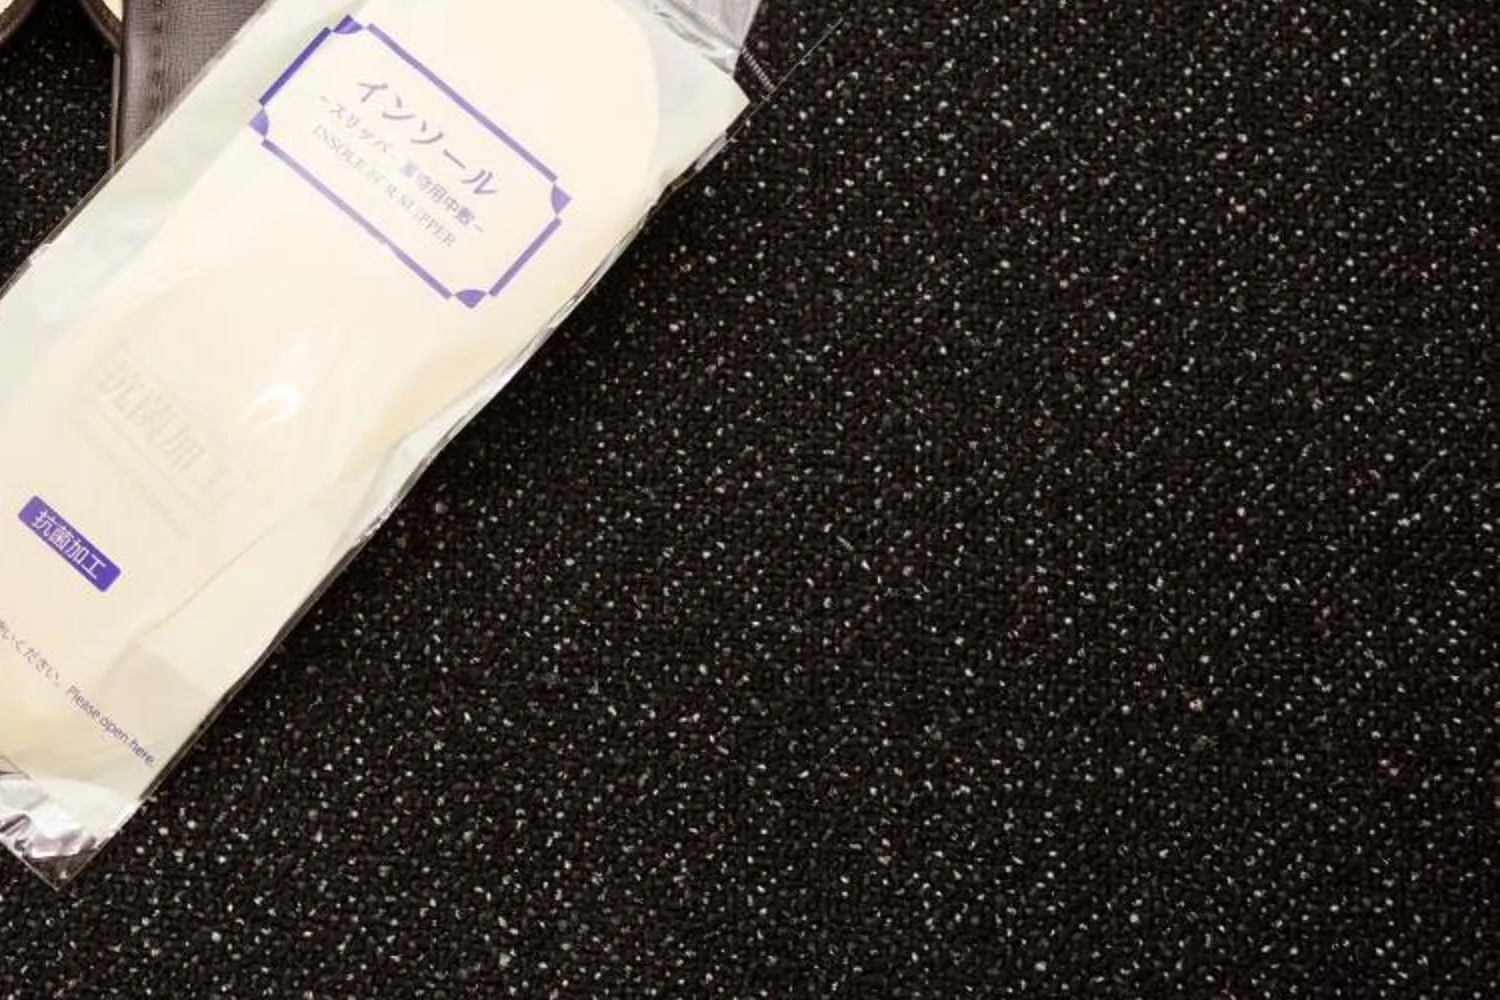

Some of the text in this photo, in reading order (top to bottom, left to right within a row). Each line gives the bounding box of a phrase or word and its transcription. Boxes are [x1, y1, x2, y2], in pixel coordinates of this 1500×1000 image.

[357, 81, 498, 197] インソール
[398, 194, 457, 249] SLIPPER
[95, 358, 235, 502] 抗菌加工
[29, 508, 107, 580] 抗菌加工
[65, 684, 101, 720] Please
[99, 714, 131, 745] open
